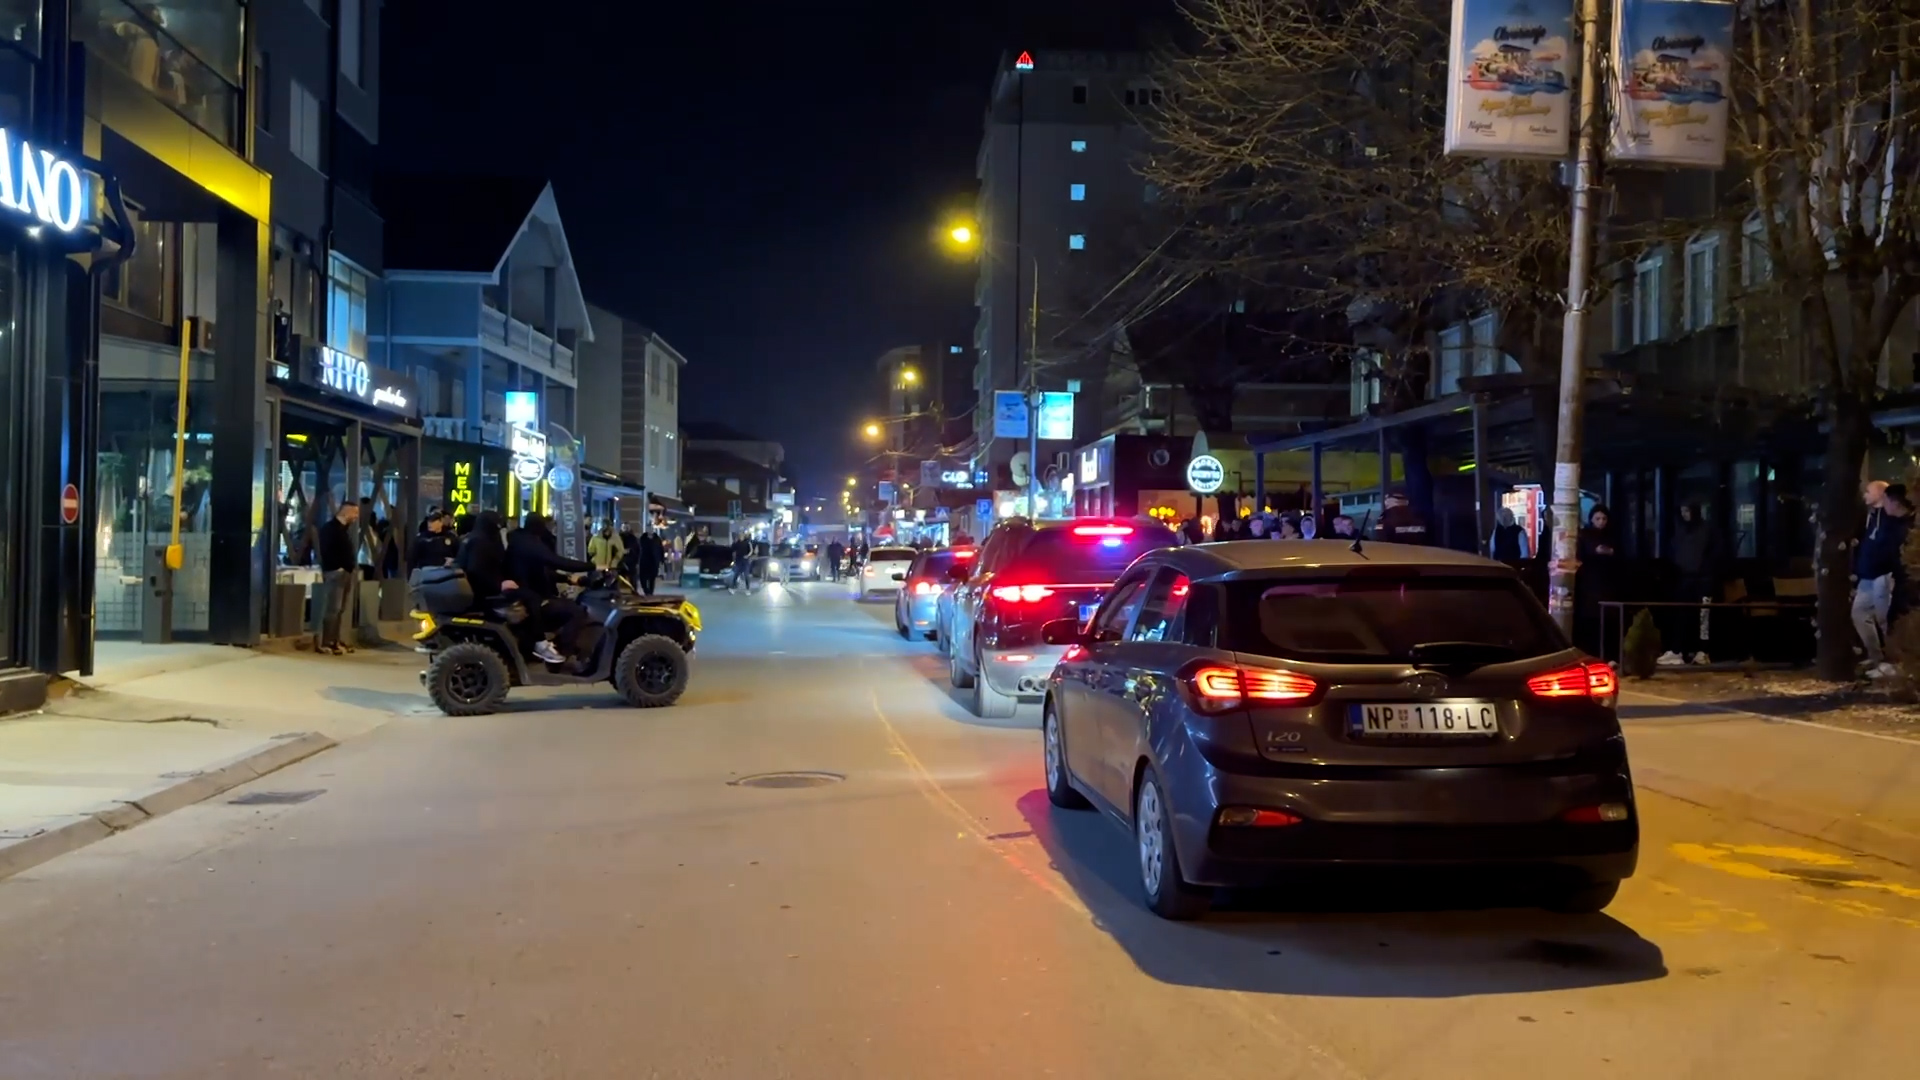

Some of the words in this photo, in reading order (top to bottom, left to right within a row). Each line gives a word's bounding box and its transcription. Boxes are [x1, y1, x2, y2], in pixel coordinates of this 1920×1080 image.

[321, 346, 369, 397] NIVO
[451, 461, 472, 530] MENJA
[1366, 706, 1394, 730] NP
